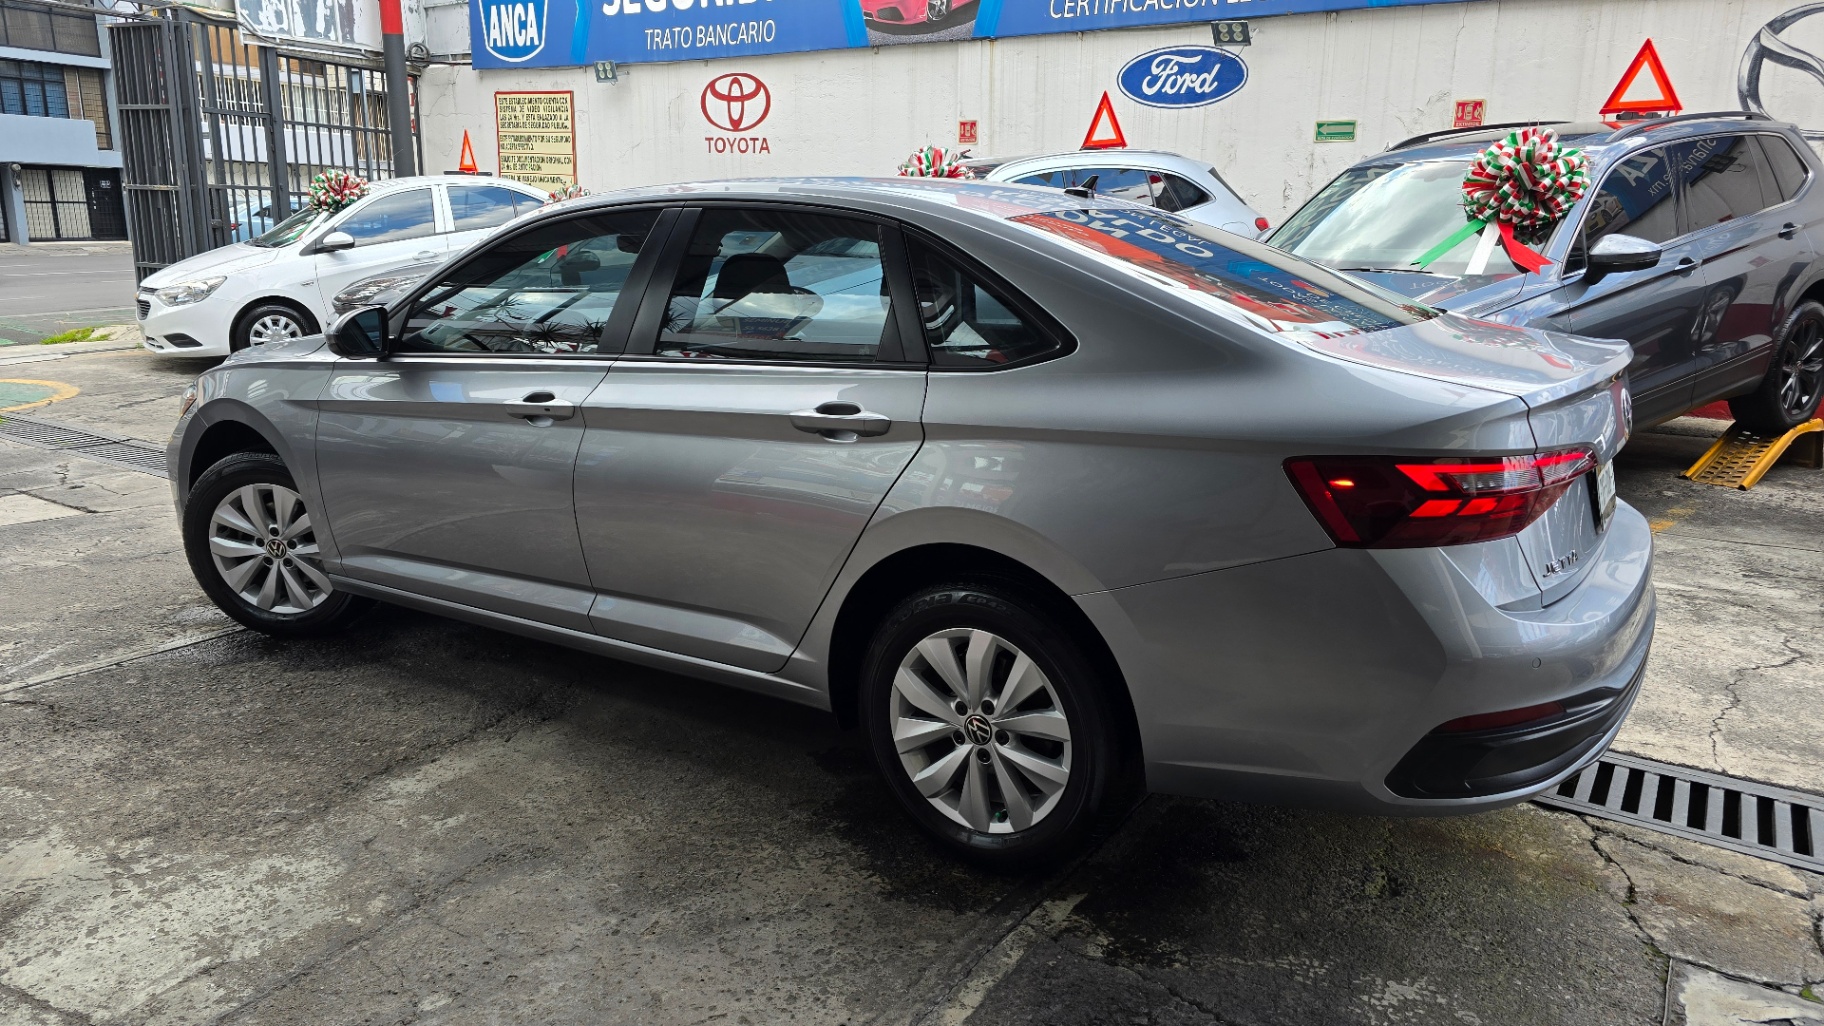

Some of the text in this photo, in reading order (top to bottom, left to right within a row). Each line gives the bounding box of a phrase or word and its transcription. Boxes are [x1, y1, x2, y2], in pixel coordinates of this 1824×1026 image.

[490, 2, 540, 47] ANCA
[645, 19, 776, 50] TRATO BANCARIO
[1142, 54, 1221, 95] Ford
[705, 137, 770, 154] TOYOTA
